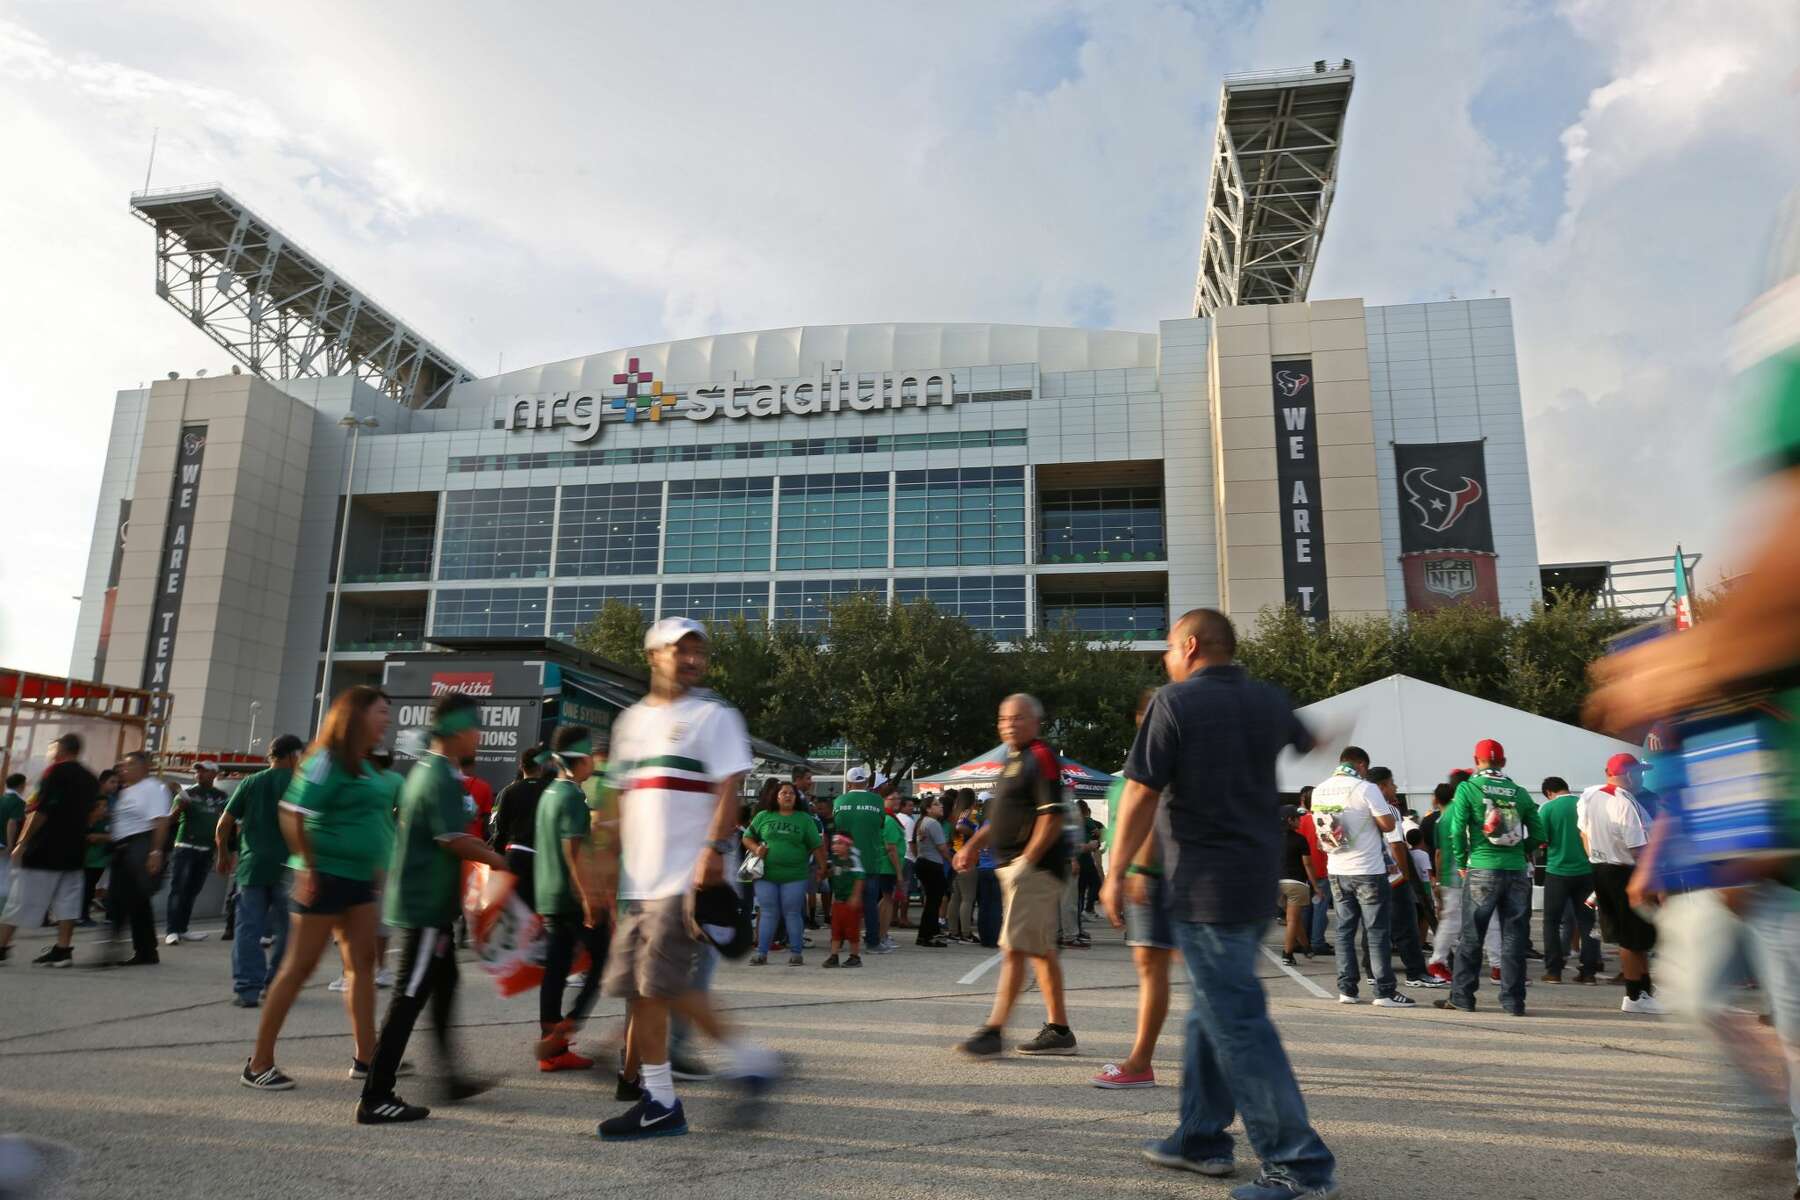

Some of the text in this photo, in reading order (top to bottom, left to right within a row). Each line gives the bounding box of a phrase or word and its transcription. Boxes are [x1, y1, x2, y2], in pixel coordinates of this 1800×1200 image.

[504, 359, 955, 443] nrg stadium
[1282, 407, 1308, 460] WE
[180, 463, 200, 509] WE
[1291, 480, 1312, 563] ARE
[166, 524, 186, 594] ARE
[1429, 570, 1472, 592] NFL
[432, 680, 493, 697] Makita
[398, 706, 434, 727] ONE
[1481, 784, 1517, 798] SANCHEZ
